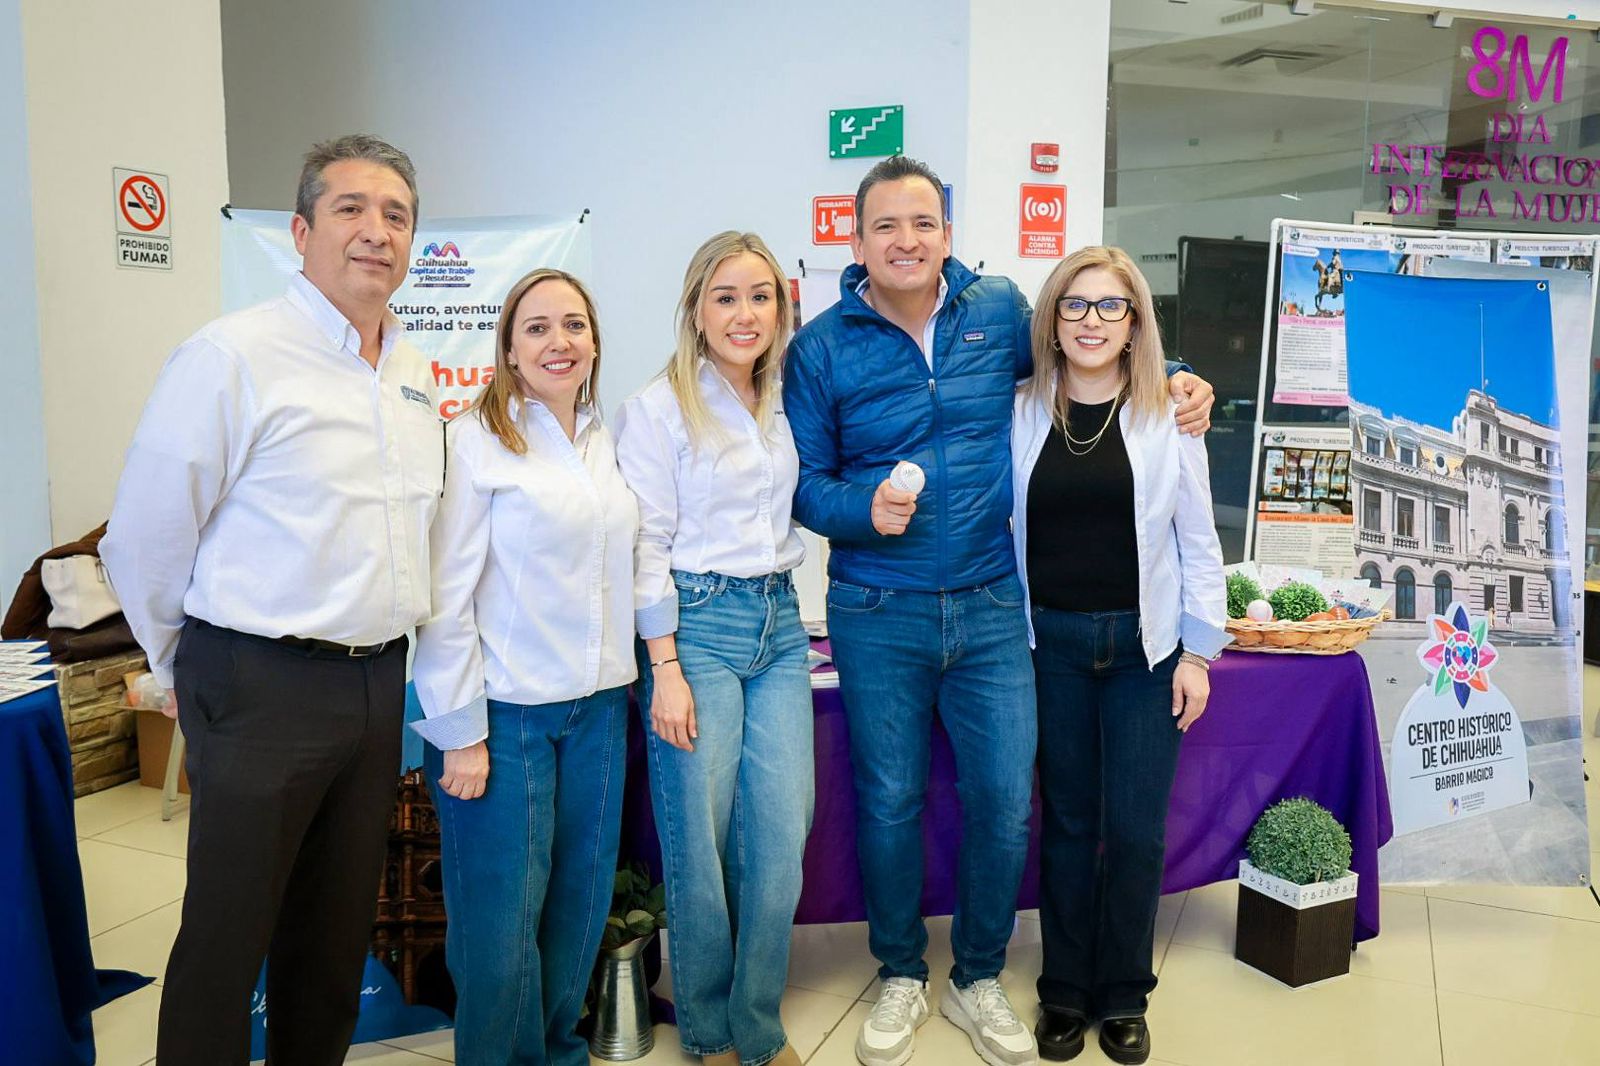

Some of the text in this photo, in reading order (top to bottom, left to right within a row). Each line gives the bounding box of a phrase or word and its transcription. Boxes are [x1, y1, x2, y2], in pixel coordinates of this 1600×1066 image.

[1466, 26, 1569, 103] 8M
[1387, 184, 1433, 216] DE
[1455, 186, 1497, 219] LA
[120, 239, 169, 252] PROHIBIDO
[123, 250, 168, 264] FUMAR
[416, 258, 469, 267] Chihuahua
[409, 267, 436, 275] Capital
[448, 267, 475, 275] Trabajo
[402, 319, 499, 331] alidad te es
[1408, 712, 1512, 746] CENTRO HISTÓRICO
[1422, 735, 1503, 770] DE CHIHUAHUA
[1435, 772, 1464, 791] BARRIO
